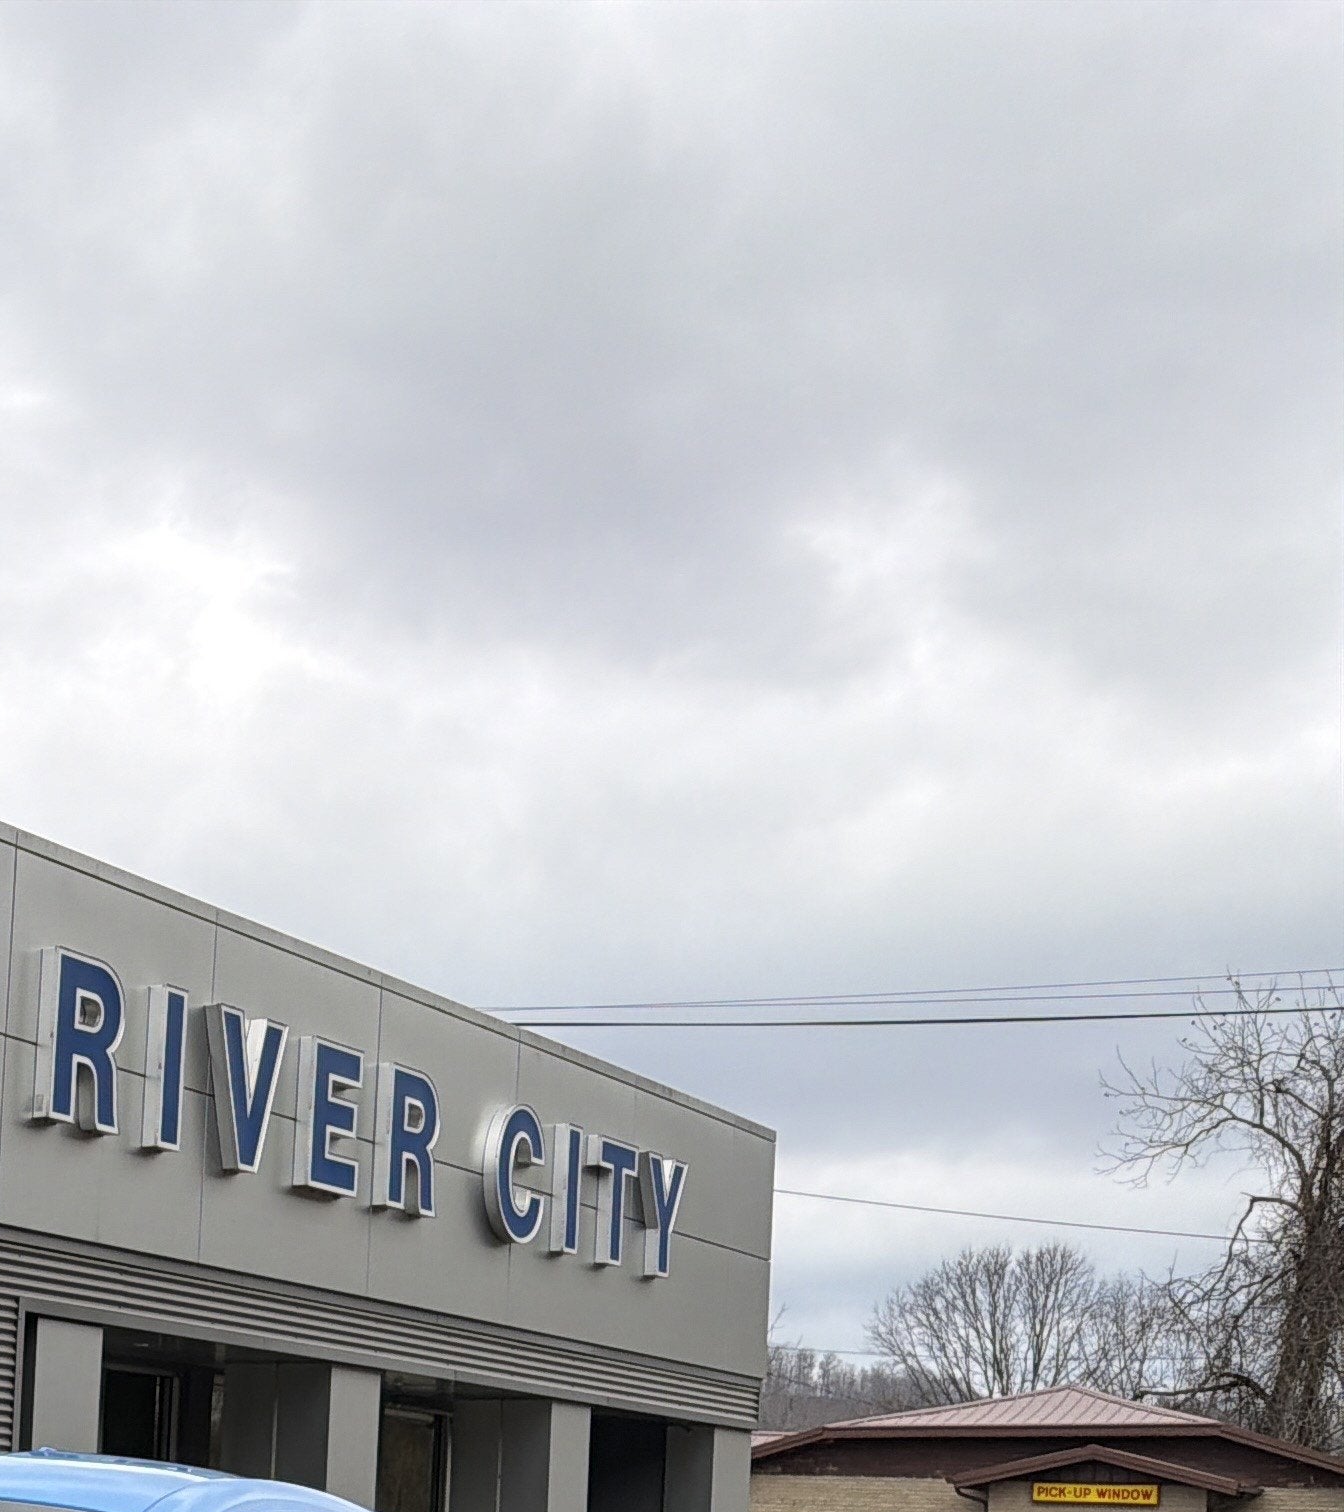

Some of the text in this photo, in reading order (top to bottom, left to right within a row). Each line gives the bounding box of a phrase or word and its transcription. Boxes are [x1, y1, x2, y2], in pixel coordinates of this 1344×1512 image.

[31, 945, 689, 1278] RIVER CITY
[1036, 1485, 1153, 1501] PICK-UP WINDOW
